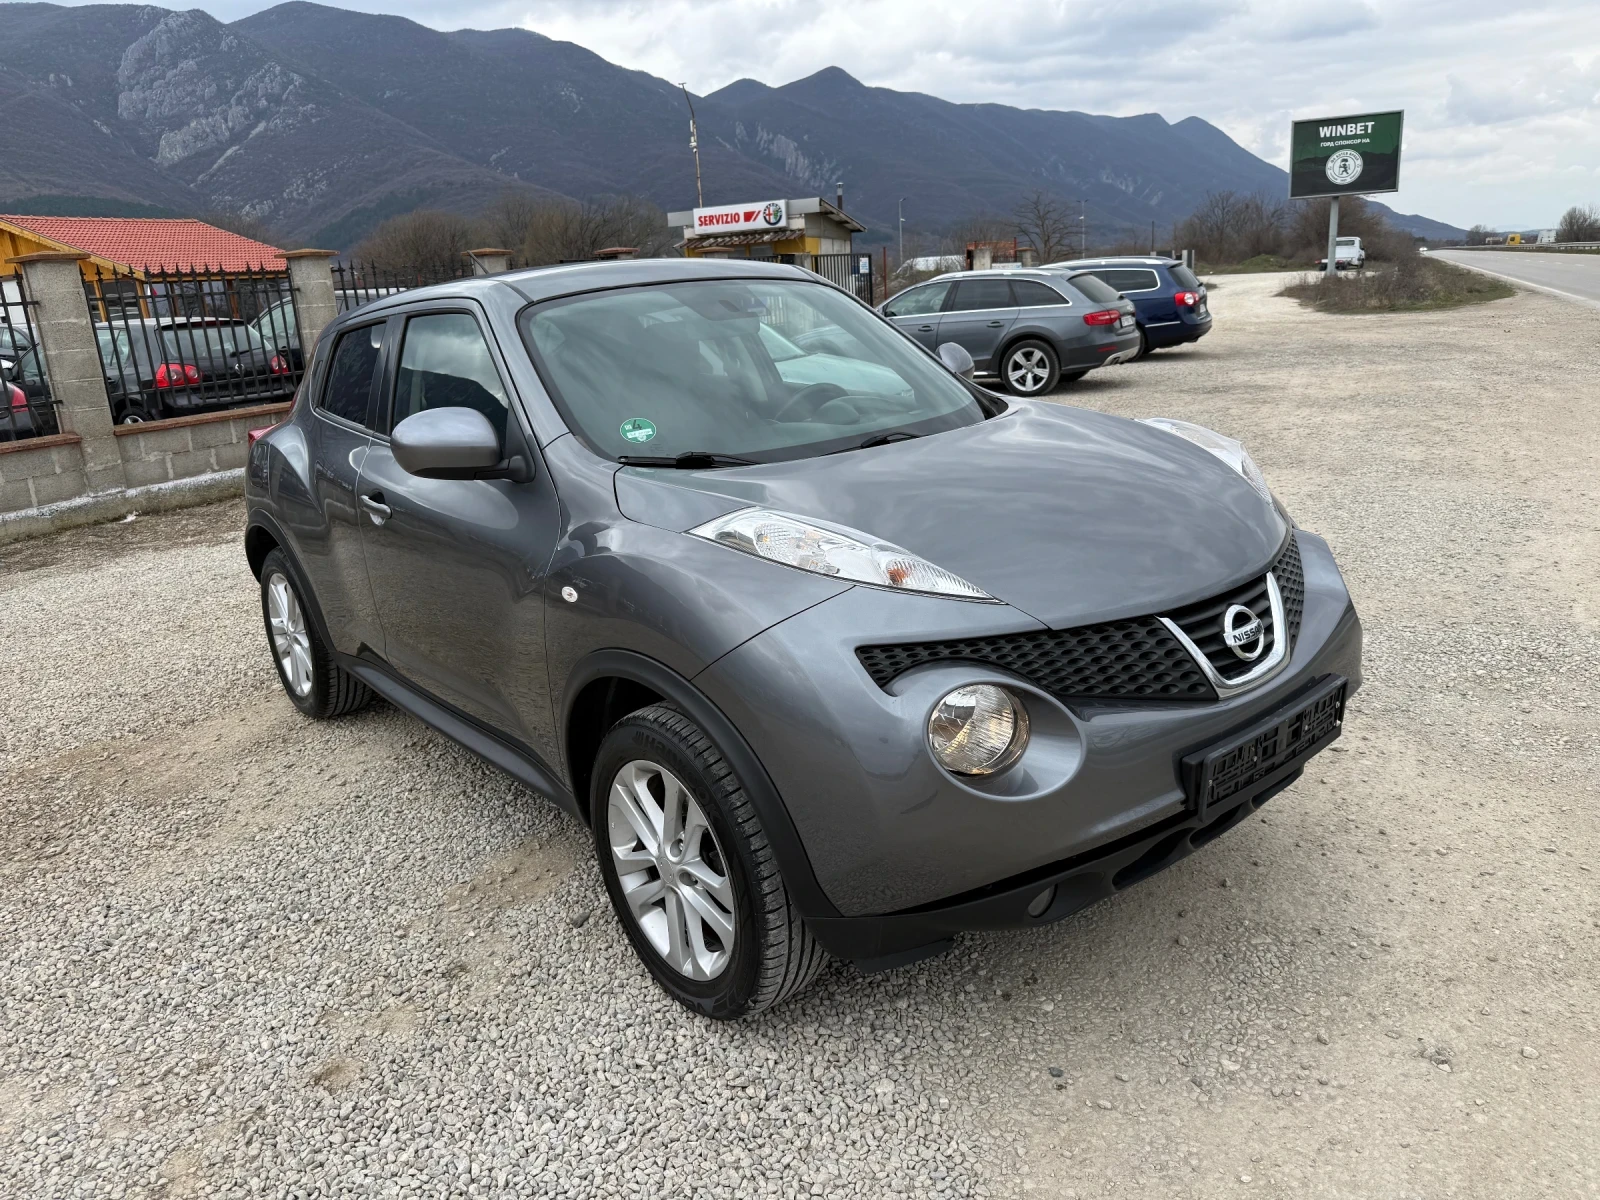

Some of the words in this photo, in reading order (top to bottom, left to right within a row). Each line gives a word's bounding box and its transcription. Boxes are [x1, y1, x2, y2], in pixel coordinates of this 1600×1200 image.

[1319, 121, 1375, 138] WINBET
[1335, 138, 1361, 146] СПОНСОР
[698, 212, 741, 227] SERVIZIO
[1232, 624, 1263, 643] NISSAN
